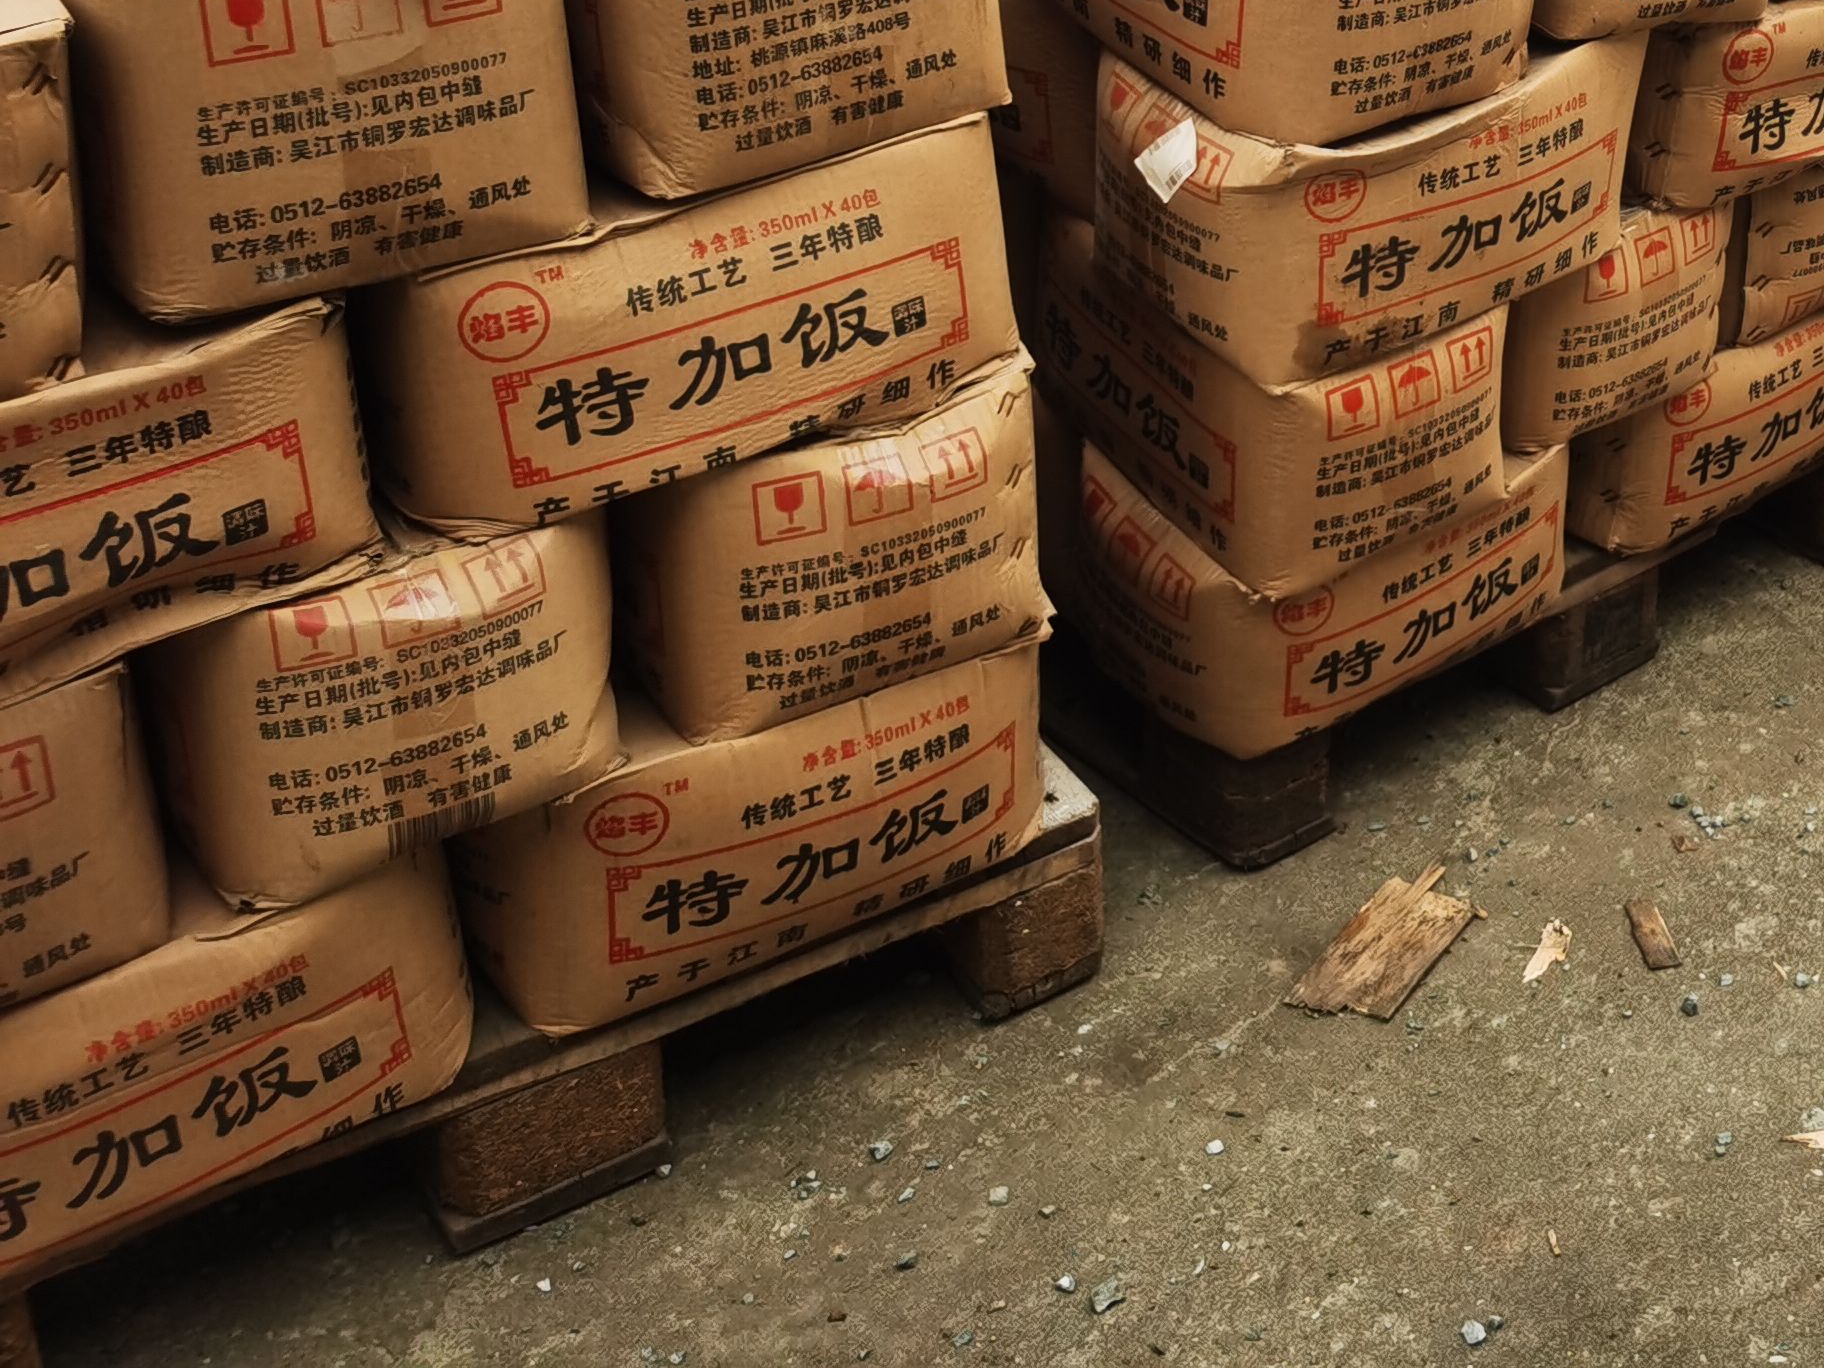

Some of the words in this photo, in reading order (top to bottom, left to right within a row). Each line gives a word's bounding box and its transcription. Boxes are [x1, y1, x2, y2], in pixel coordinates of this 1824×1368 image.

[1115, 19, 1226, 100] 精研细作
[736, 117, 812, 153] 过量饮酒
[832, 89, 904, 125] 有害健康
[1418, 155, 1501, 197] 传统工艺
[1517, 121, 1584, 166] 三年特酿
[840, 188, 880, 214] 40包
[1341, 178, 1569, 299] 特加饭
[256, 249, 350, 285] 过量饮酒
[375, 222, 463, 257] 有害健康
[625, 257, 748, 316] 传统工艺
[769, 213, 883, 272] 三年特酿
[536, 288, 890, 447] 特加饭
[1748, 359, 1803, 401] 传统工艺
[65, 409, 211, 478] 三年特酿
[1382, 554, 1454, 604] 传统工艺
[1466, 506, 1531, 559] 三年特酿
[1310, 557, 1522, 694] 特加饭
[313, 804, 405, 837] 过量饮酒
[428, 765, 512, 808] 有害健康
[664, 778, 689, 795] TM
[741, 774, 852, 830] 传统工艺
[874, 722, 972, 786] 三年特酿
[643, 788, 958, 935] 特加饭
[8, 1051, 148, 1128] 传统工艺
[176, 974, 307, 1055] 三年特酿
